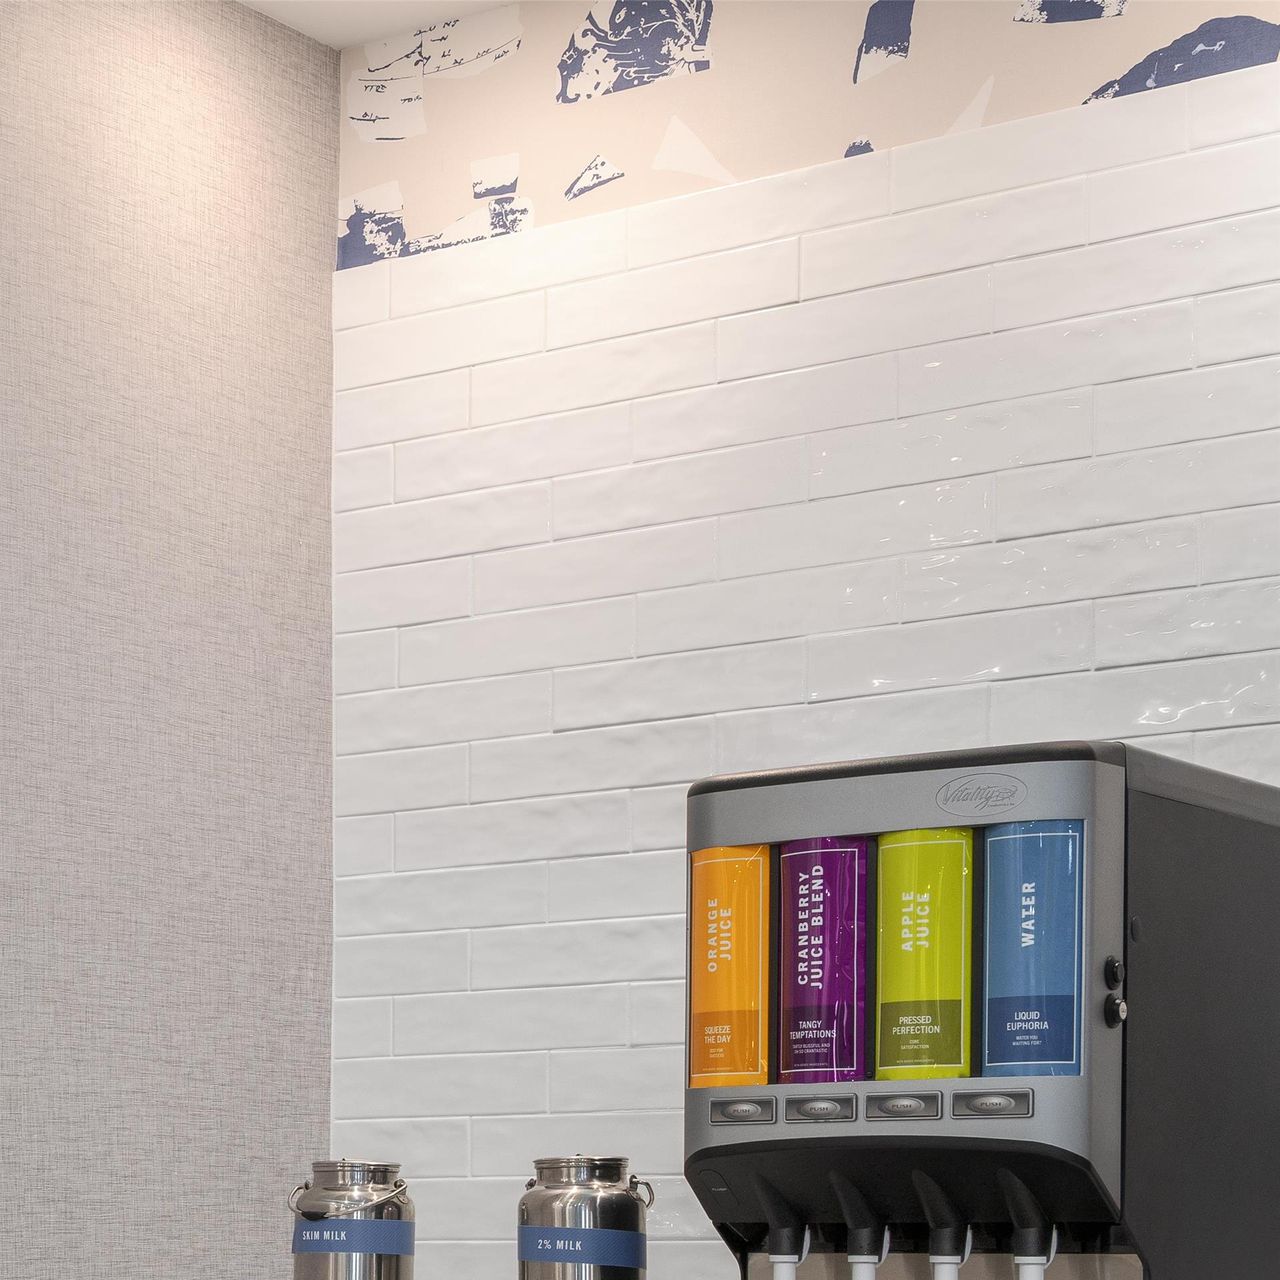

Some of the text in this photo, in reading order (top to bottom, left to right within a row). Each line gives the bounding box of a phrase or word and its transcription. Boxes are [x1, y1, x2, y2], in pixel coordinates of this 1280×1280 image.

[916, 892, 930, 948] JUICE
[1021, 882, 1036, 948] WATER
[902, 891, 914, 951] APPLE
[797, 872, 810, 985] CRANBERRY
[810, 865, 824, 990] JUICE BLEND
[707, 898, 718, 972] ORANGE
[720, 908, 732, 960] JUICE
[899, 1015, 932, 1024] PRESSED
[1014, 1011, 1040, 1021] LIQUID
[704, 1025, 731, 1035] SQUEEZE
[799, 1020, 822, 1030] TANGY
[892, 1025, 940, 1035] PERFECTION
[1006, 1021, 1049, 1031] EUPHORIA
[704, 1034, 731, 1044] THE DAY
[790, 1029, 837, 1040] TEMPTATIONS
[302, 1230, 347, 1241] SKIM MILK
[537, 1239, 582, 1251] 2% MILK
